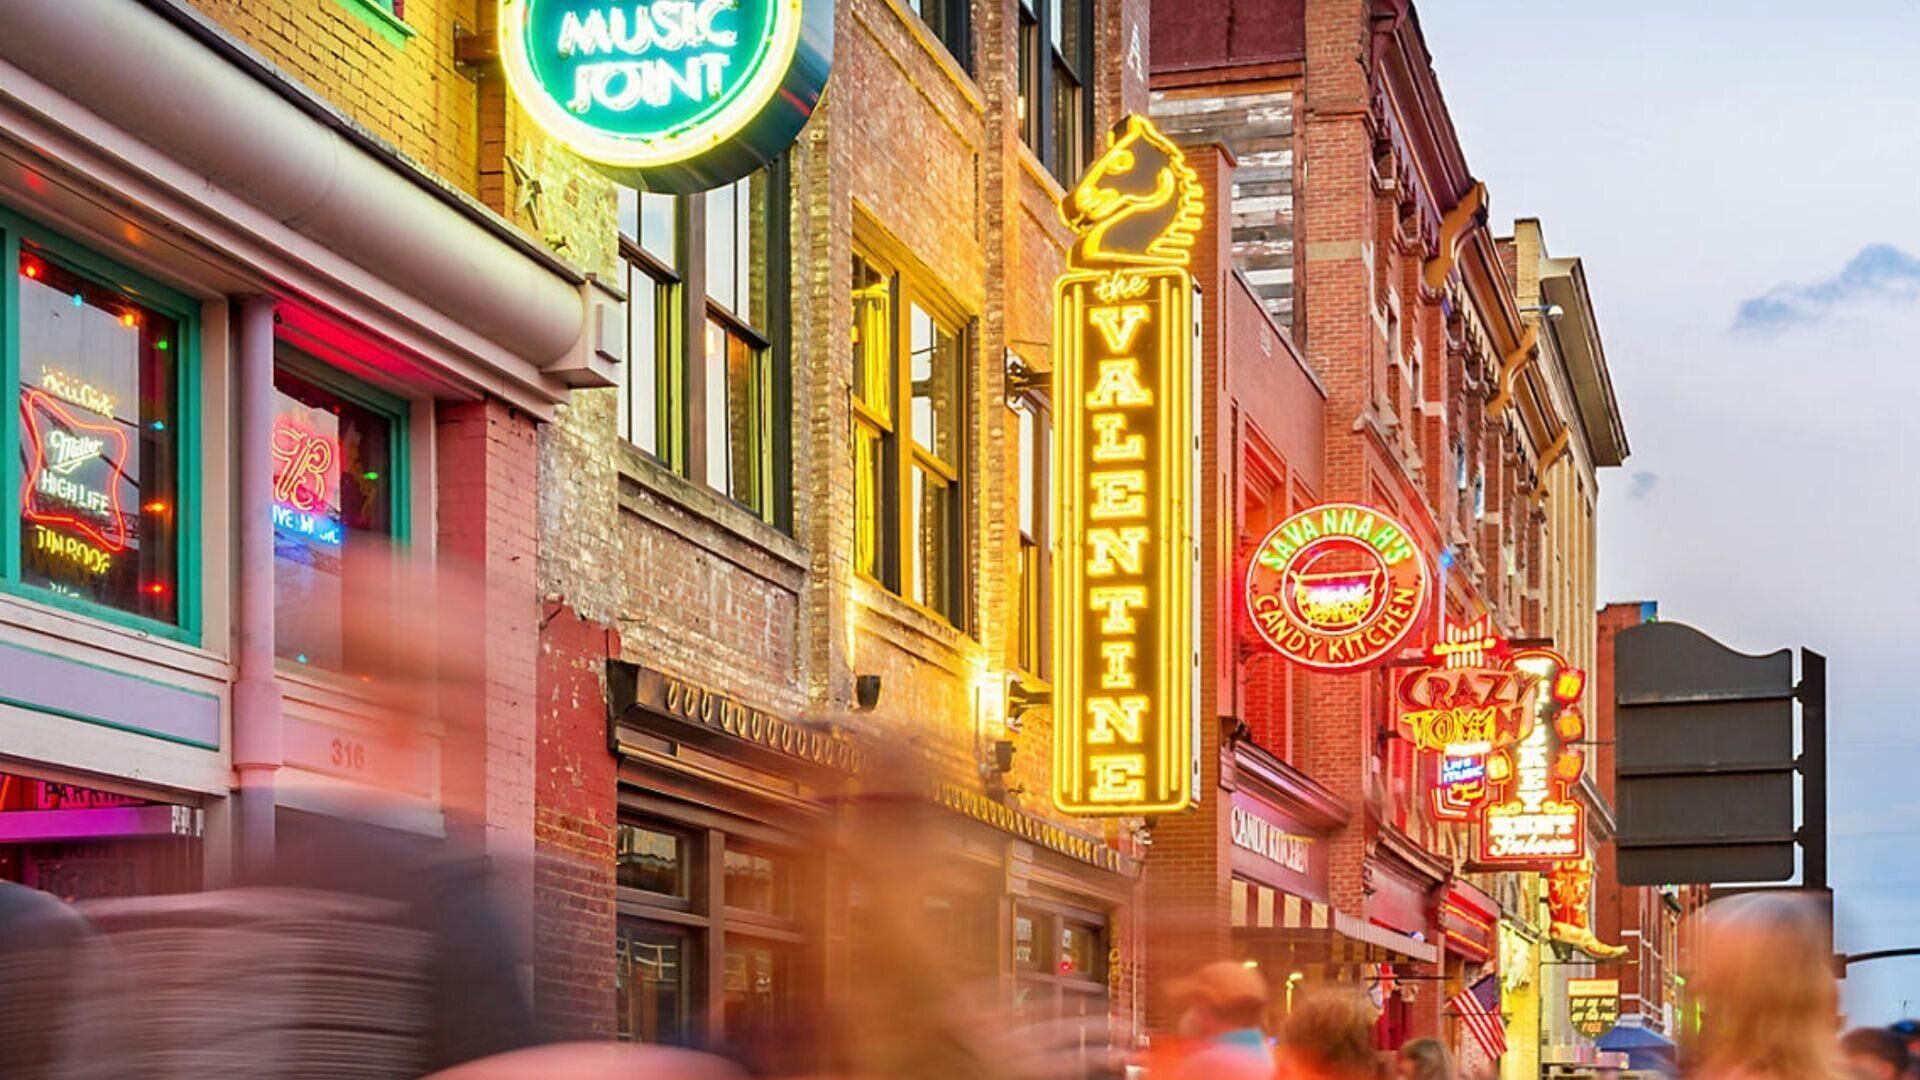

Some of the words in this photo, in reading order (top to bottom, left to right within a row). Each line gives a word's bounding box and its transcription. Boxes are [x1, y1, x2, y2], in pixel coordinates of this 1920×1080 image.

[557, 0, 737, 57] MUSIC
[566, 53, 730, 114] JOINT
[1094, 270, 1150, 302] the
[50, 430, 103, 463] Miller
[41, 468, 78, 504] HIGH
[79, 483, 110, 517] LIFE
[1086, 304, 1154, 802] VALENTINE
[1259, 509, 1412, 572] SAVANNAH'S
[1255, 595, 1323, 659] CANDY
[1328, 587, 1415, 661] KITCHEN
[1398, 667, 1540, 712] CRAZY
[1401, 706, 1524, 750] TOWN
[331, 738, 365, 770] 316
[1231, 806, 1268, 856] CANDY
